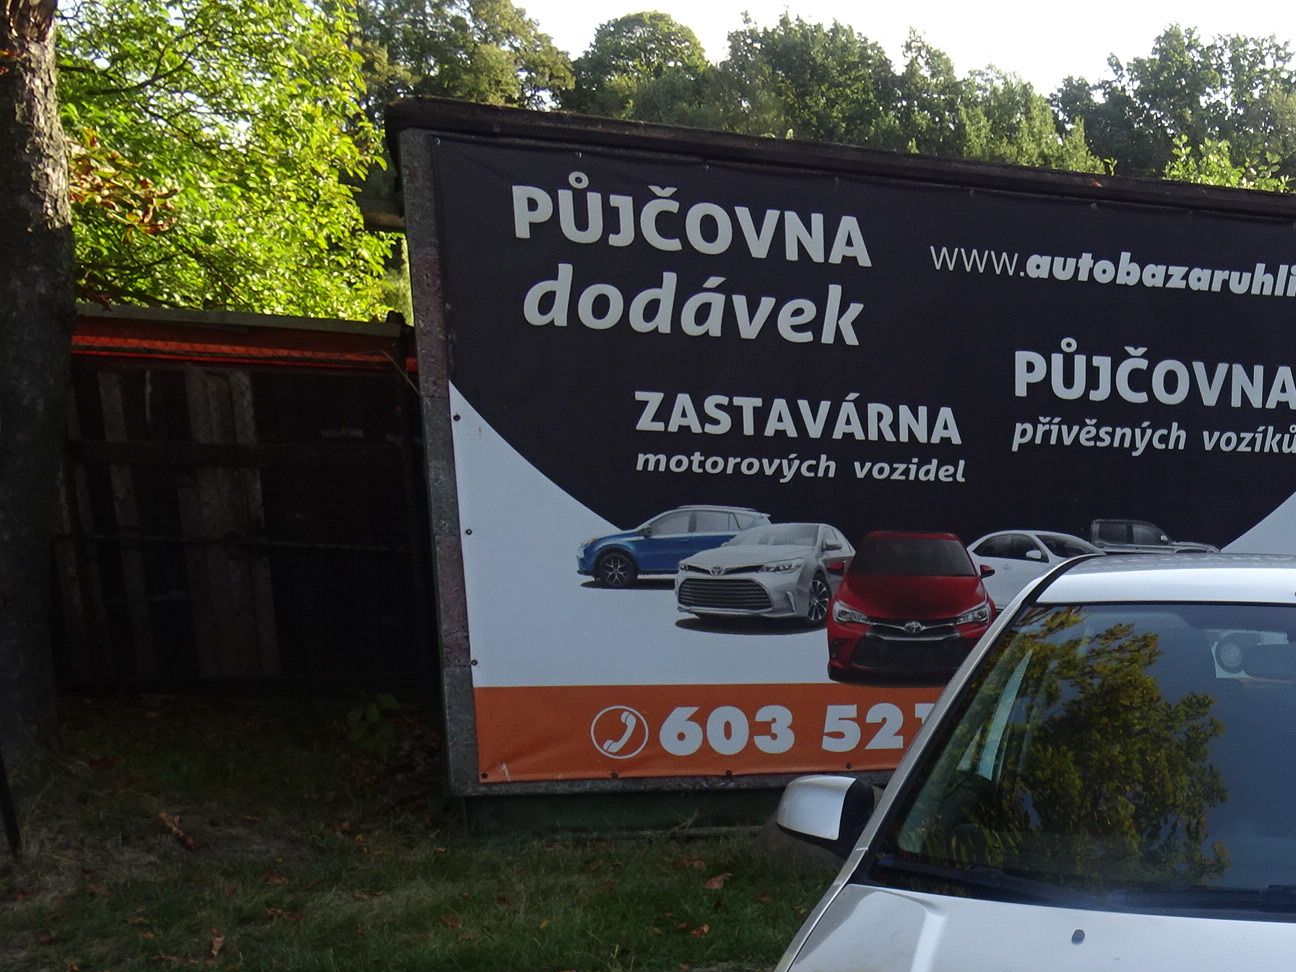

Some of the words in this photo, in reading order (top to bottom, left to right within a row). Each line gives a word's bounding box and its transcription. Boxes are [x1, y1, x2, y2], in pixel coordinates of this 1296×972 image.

[511, 171, 873, 267] PŮJČOVNA
[523, 263, 865, 346] dodávek
[634, 392, 963, 445] ZASTAVÁRNA
[1011, 416, 1187, 457] přívěsných
[635, 451, 837, 483] motorových
[853, 457, 966, 483] vozidel
[659, 704, 795, 757] 603
